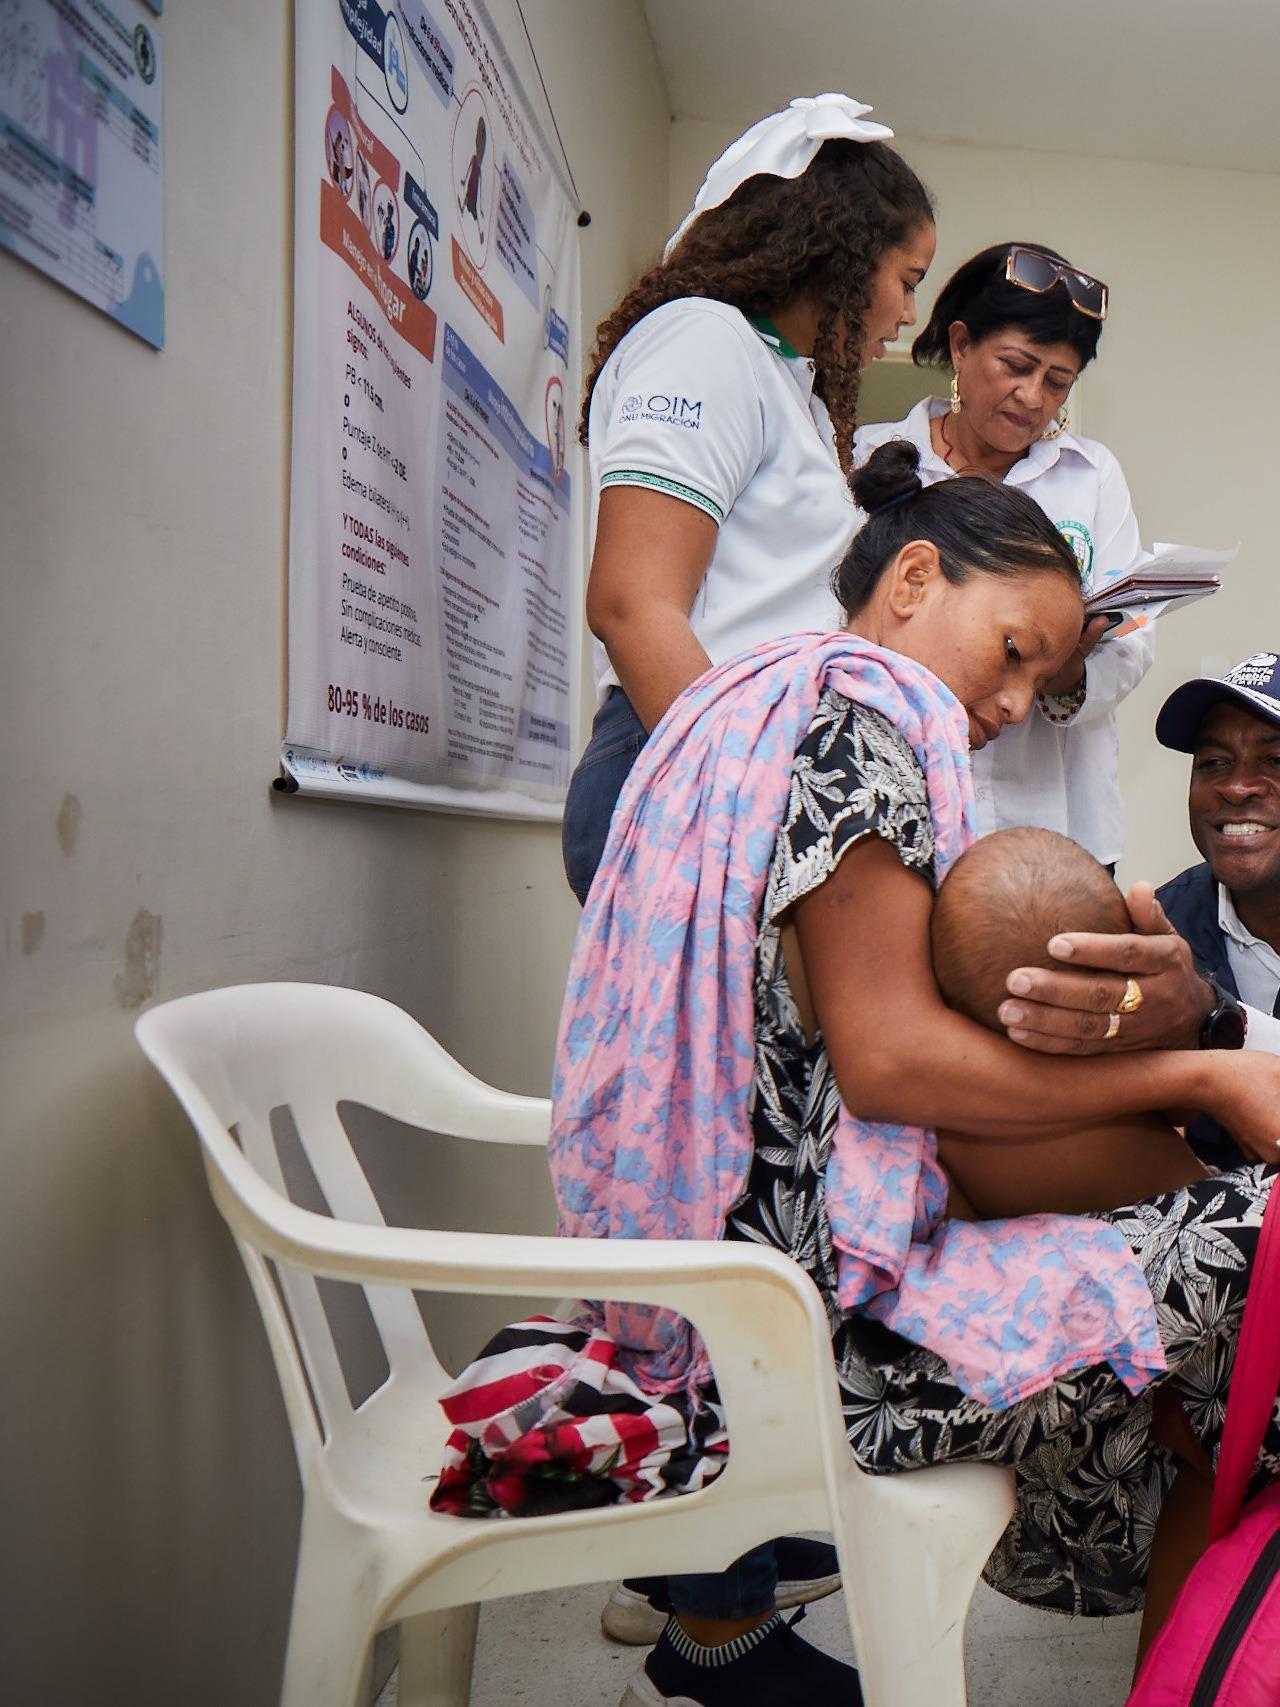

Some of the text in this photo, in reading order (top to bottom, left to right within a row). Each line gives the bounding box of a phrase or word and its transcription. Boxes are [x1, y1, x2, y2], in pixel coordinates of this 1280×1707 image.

[377, 264, 406, 322] hogar
[347, 300, 376, 344] ALGUNOS
[345, 363, 356, 385] PB
[640, 413, 700, 430] MIGRACIÓN
[648, 395, 702, 420] OIM
[343, 416, 371, 451] Puntaje
[342, 468, 367, 498] Edema
[342, 512, 348, 530] Y
[349, 516, 374, 544] TODAS
[375, 530, 385, 550] las
[341, 543, 386, 575] condiciones:
[342, 572, 367, 598] Prueba
[368, 584, 376, 603] de
[377, 592, 400, 613] apetito
[341, 599, 353, 619] Sin
[354, 607, 403, 638] complicaciones
[340, 625, 363, 648] Alerta
[328, 684, 430, 734] 80-95 % de los casos
